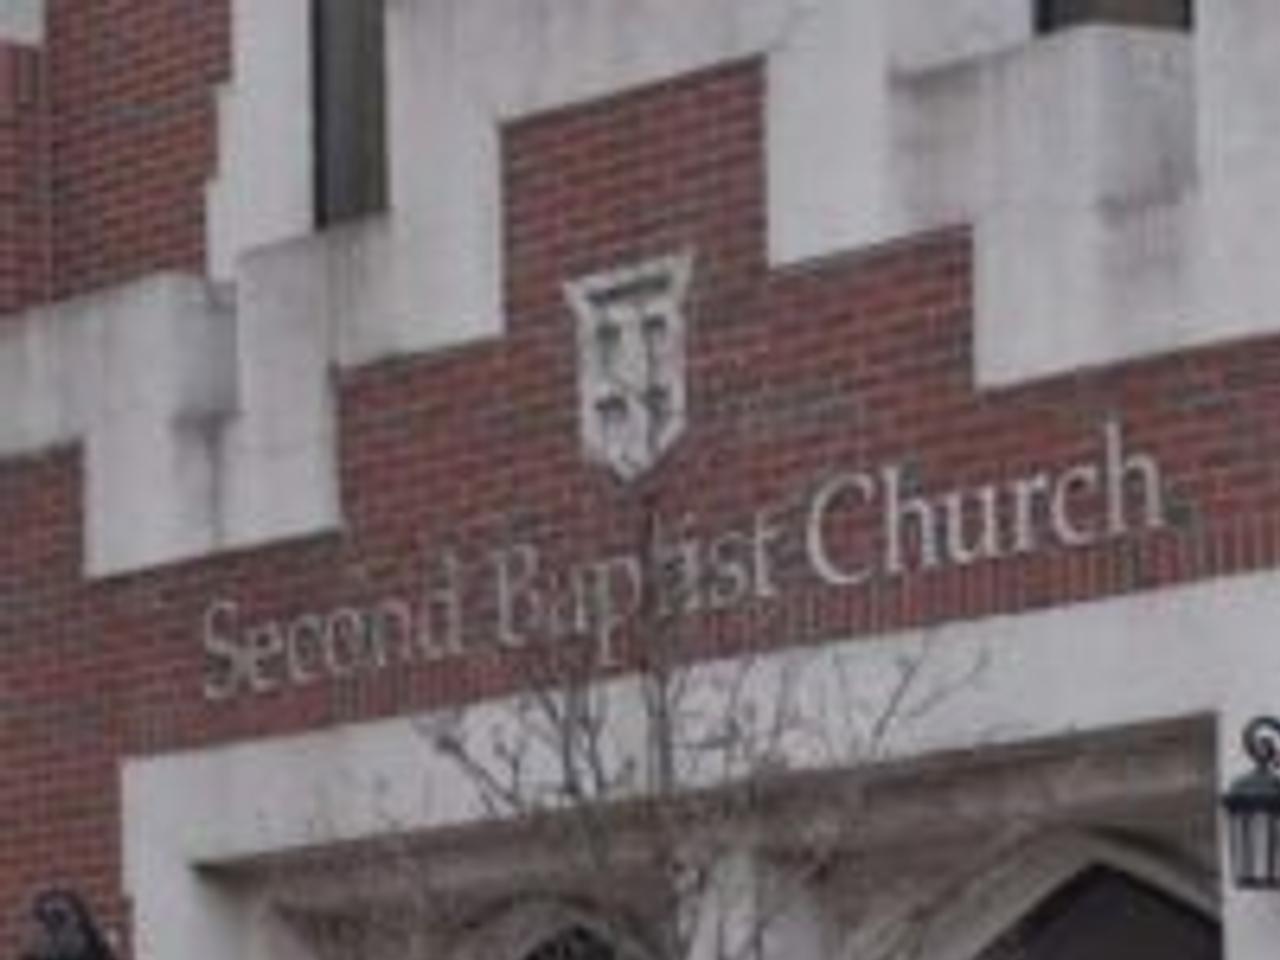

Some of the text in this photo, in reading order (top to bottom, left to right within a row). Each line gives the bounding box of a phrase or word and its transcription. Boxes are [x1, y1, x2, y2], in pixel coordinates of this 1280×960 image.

[200, 424, 1167, 698] Second Baptist Church
